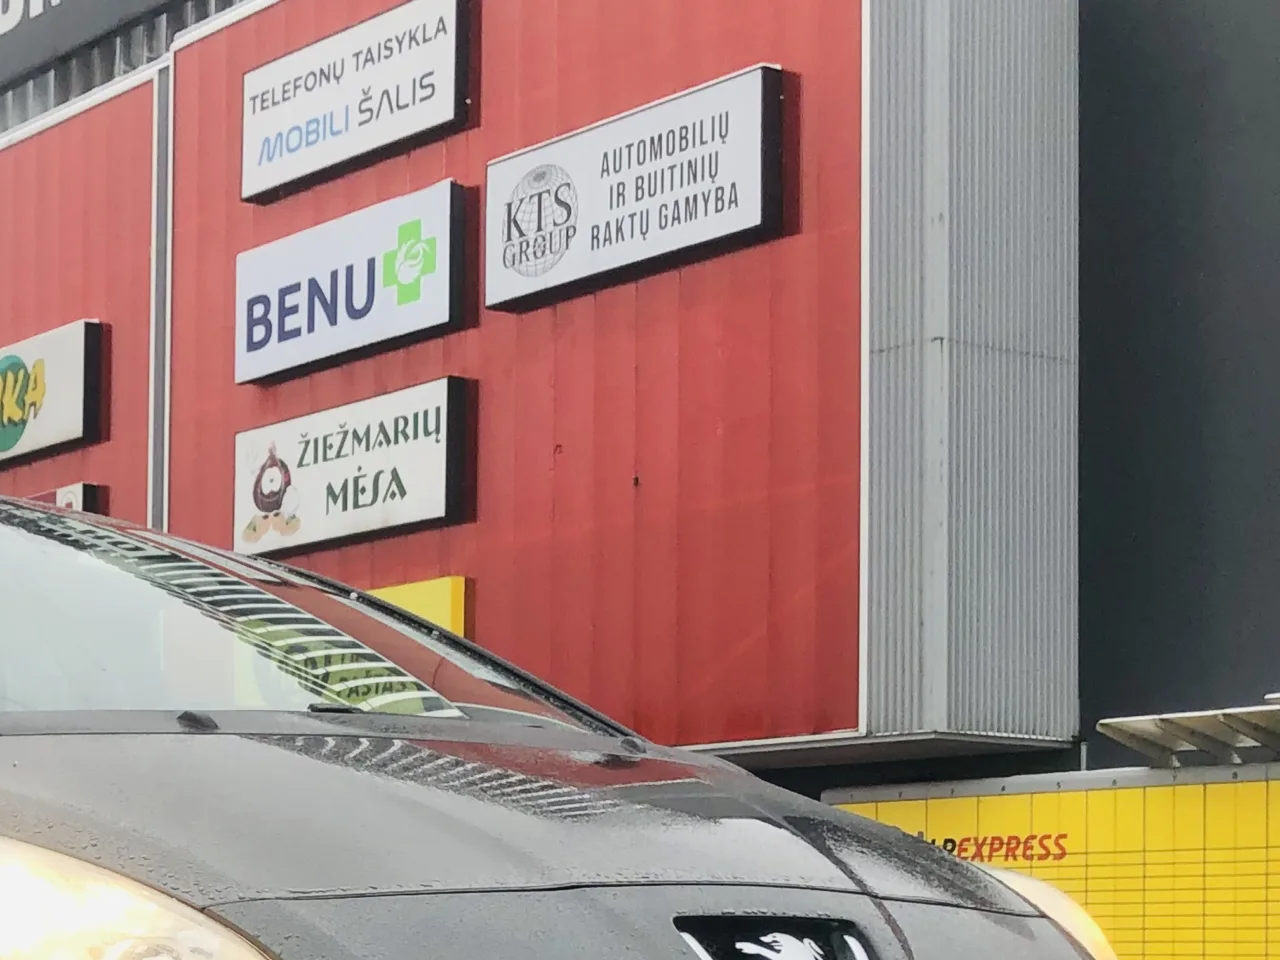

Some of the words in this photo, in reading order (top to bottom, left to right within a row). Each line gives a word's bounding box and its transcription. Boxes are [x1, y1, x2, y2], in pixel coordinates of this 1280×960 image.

[249, 58, 345, 116] TELEFONŲ
[352, 16, 448, 73] TAISYKLA
[258, 104, 350, 167] MOBILI
[358, 70, 436, 127] ŠALIS
[600, 110, 730, 179] AUTOMOBILIŲ
[504, 182, 572, 243] KTS
[609, 181, 626, 211] IR
[635, 151, 719, 203] BUITINIŲ
[502, 224, 577, 270] GROUP
[590, 208, 650, 252] RAKTŲ
[658, 181, 740, 231] GAMYBA
[246, 256, 376, 353] BENU
[296, 405, 442, 469] ŽIEŽMARIŲ
[325, 464, 408, 517] MĖSA
